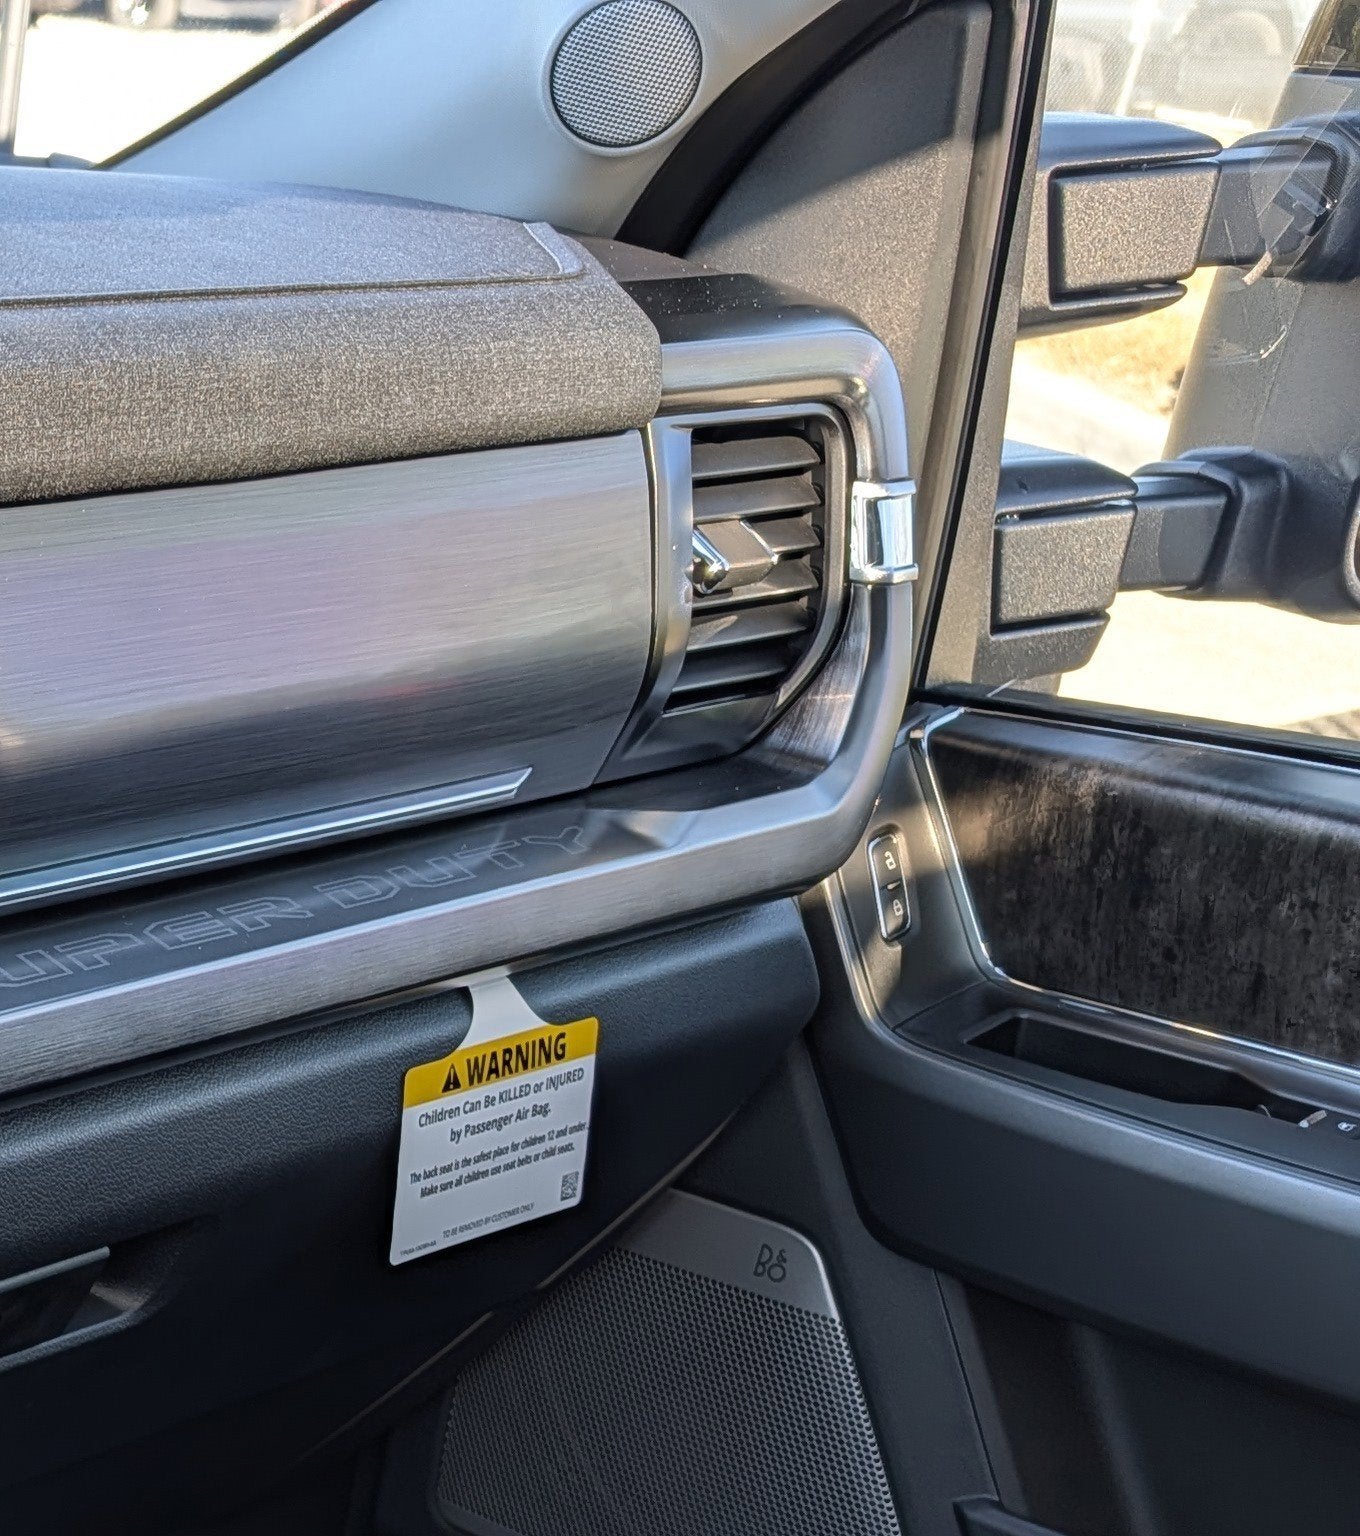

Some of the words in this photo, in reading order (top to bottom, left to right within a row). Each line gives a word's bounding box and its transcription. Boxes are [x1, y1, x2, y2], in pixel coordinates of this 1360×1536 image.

[314, 825, 588, 909] DUTY
[466, 1032, 566, 1086] WARNING
[418, 1106, 460, 1128] Children
[462, 1100, 481, 1115] Can
[484, 1095, 496, 1109] Be
[498, 1083, 531, 1104] KILLED
[533, 1083, 544, 1094] or
[545, 1068, 584, 1093] INJURED
[450, 1128, 463, 1145] by
[464, 1114, 514, 1139] Passenger
[514, 1106, 531, 1122] Air
[531, 1102, 551, 1120] Bag.
[410, 1172, 421, 1185] The
[423, 1166, 438, 1180] back
[439, 1161, 453, 1175] seat
[460, 1155, 472, 1168] the
[493, 1145, 509, 1161] place
[510, 1141, 520, 1152] for
